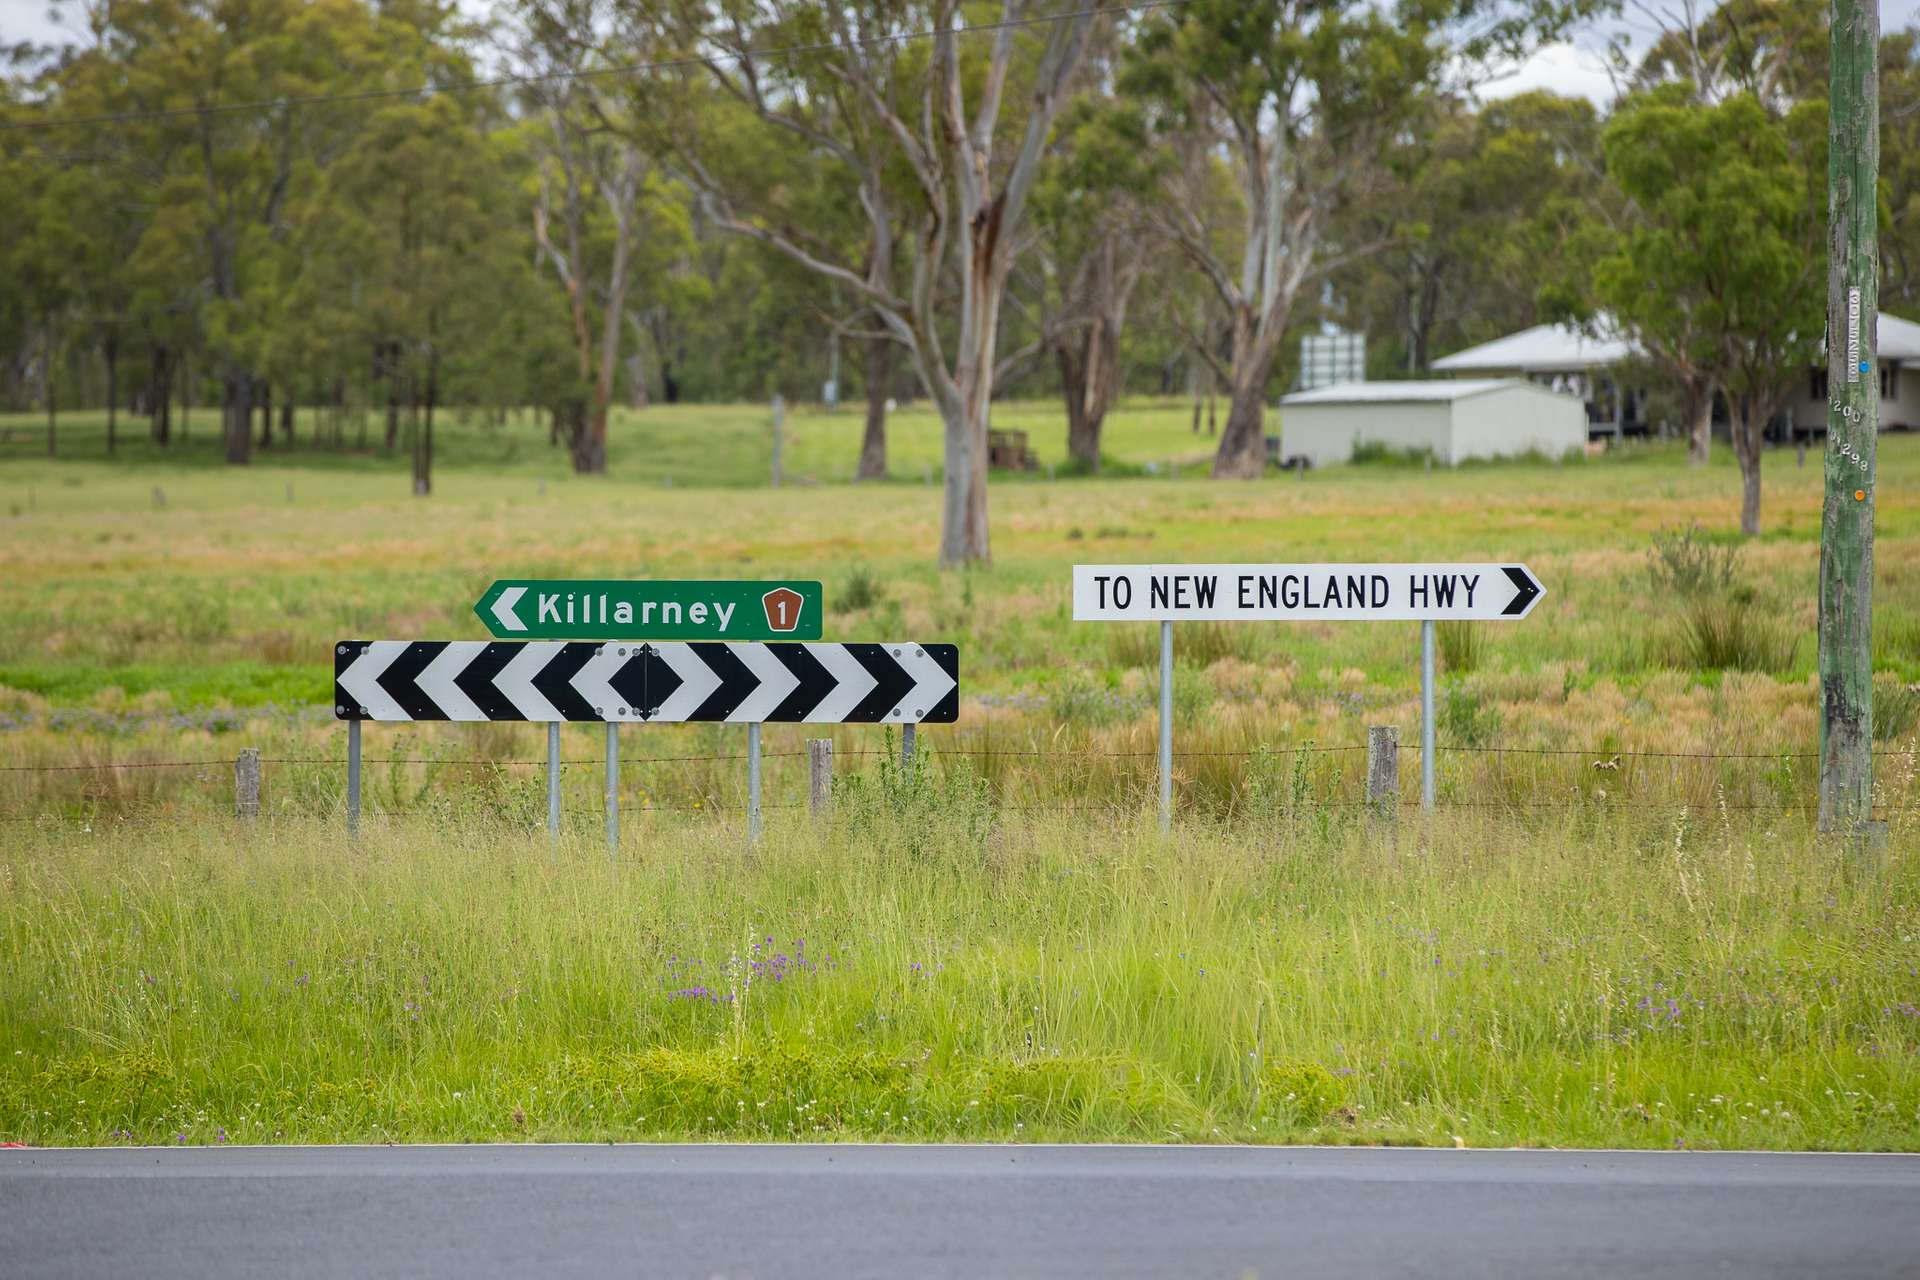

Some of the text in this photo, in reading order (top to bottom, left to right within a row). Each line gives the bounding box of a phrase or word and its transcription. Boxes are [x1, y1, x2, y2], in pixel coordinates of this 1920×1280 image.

[1094, 574, 1480, 610] TO NEW ENGLAND HWY
[538, 593, 737, 632] Killarney
[777, 601, 786, 625] 1
